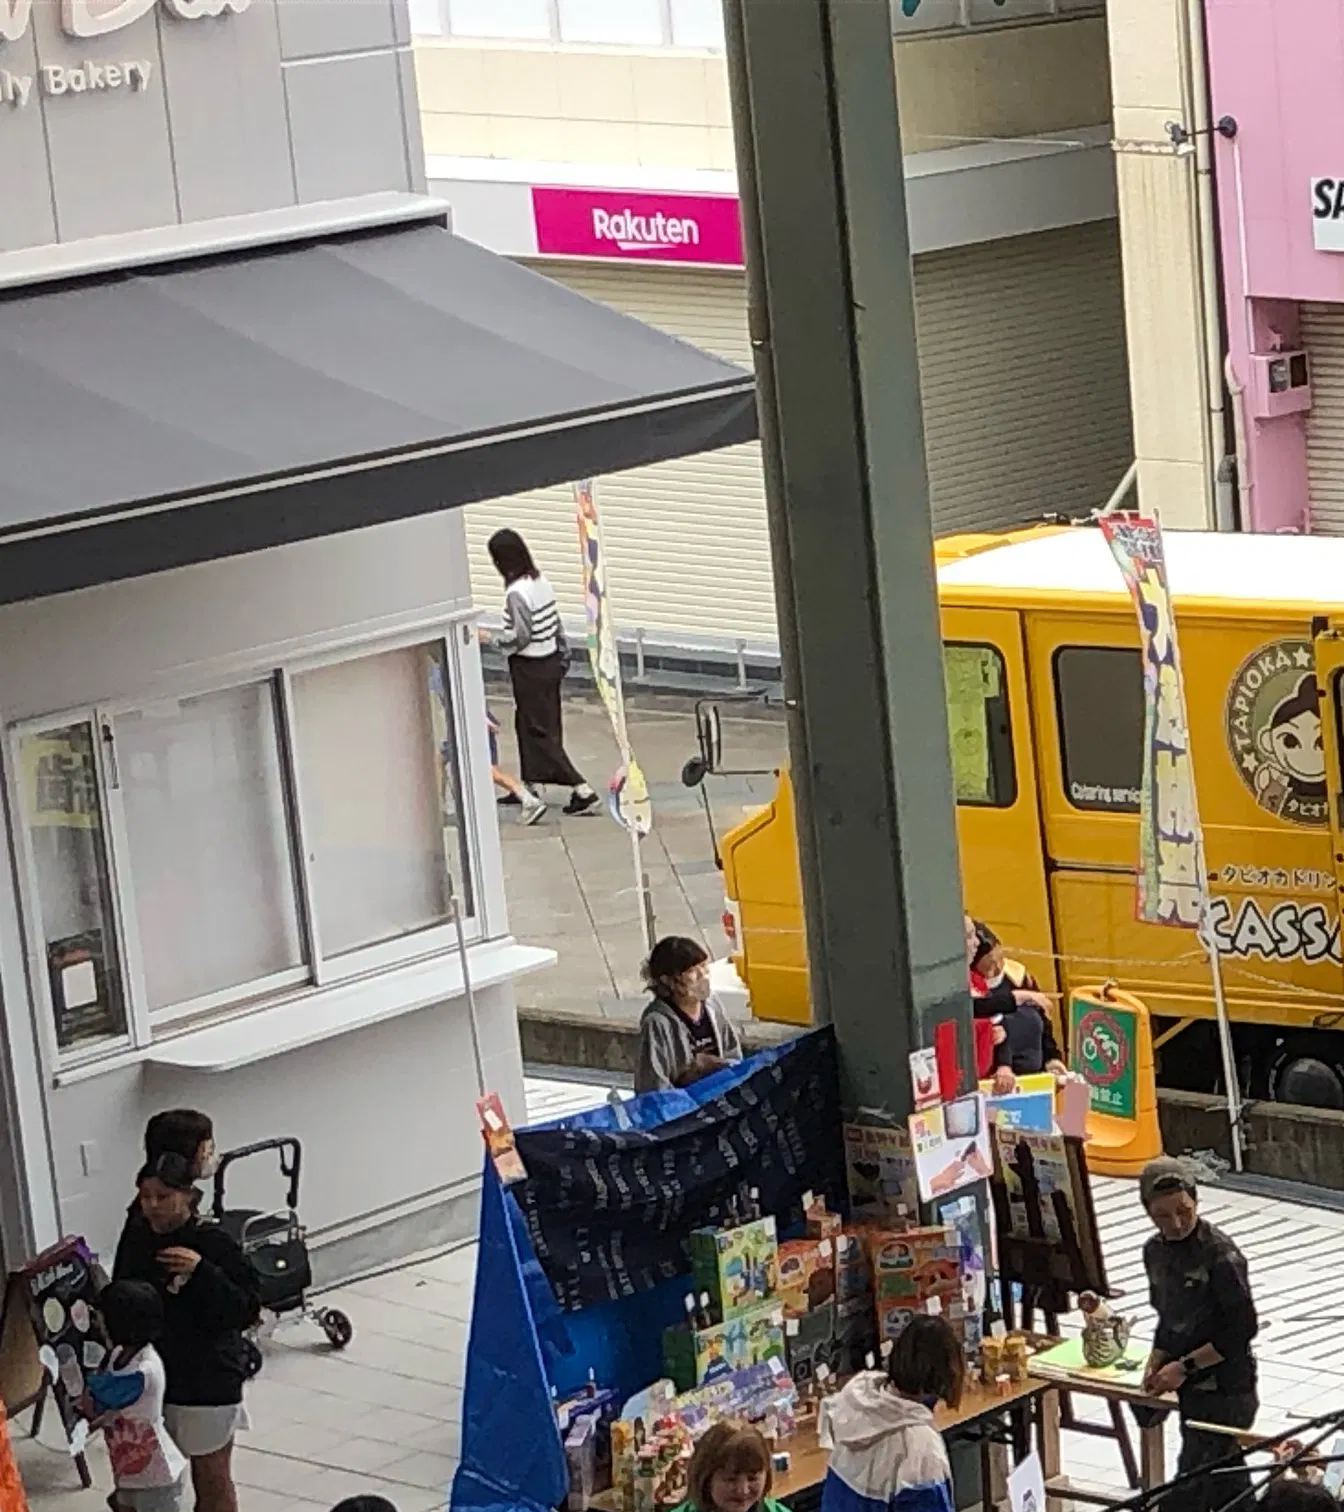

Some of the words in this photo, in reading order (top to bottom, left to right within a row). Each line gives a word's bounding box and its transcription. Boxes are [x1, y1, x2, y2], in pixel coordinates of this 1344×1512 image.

[46, 60, 151, 95] Bakery
[593, 208, 699, 246] Rakuten
[1231, 650, 1294, 748] TAPIOKA
